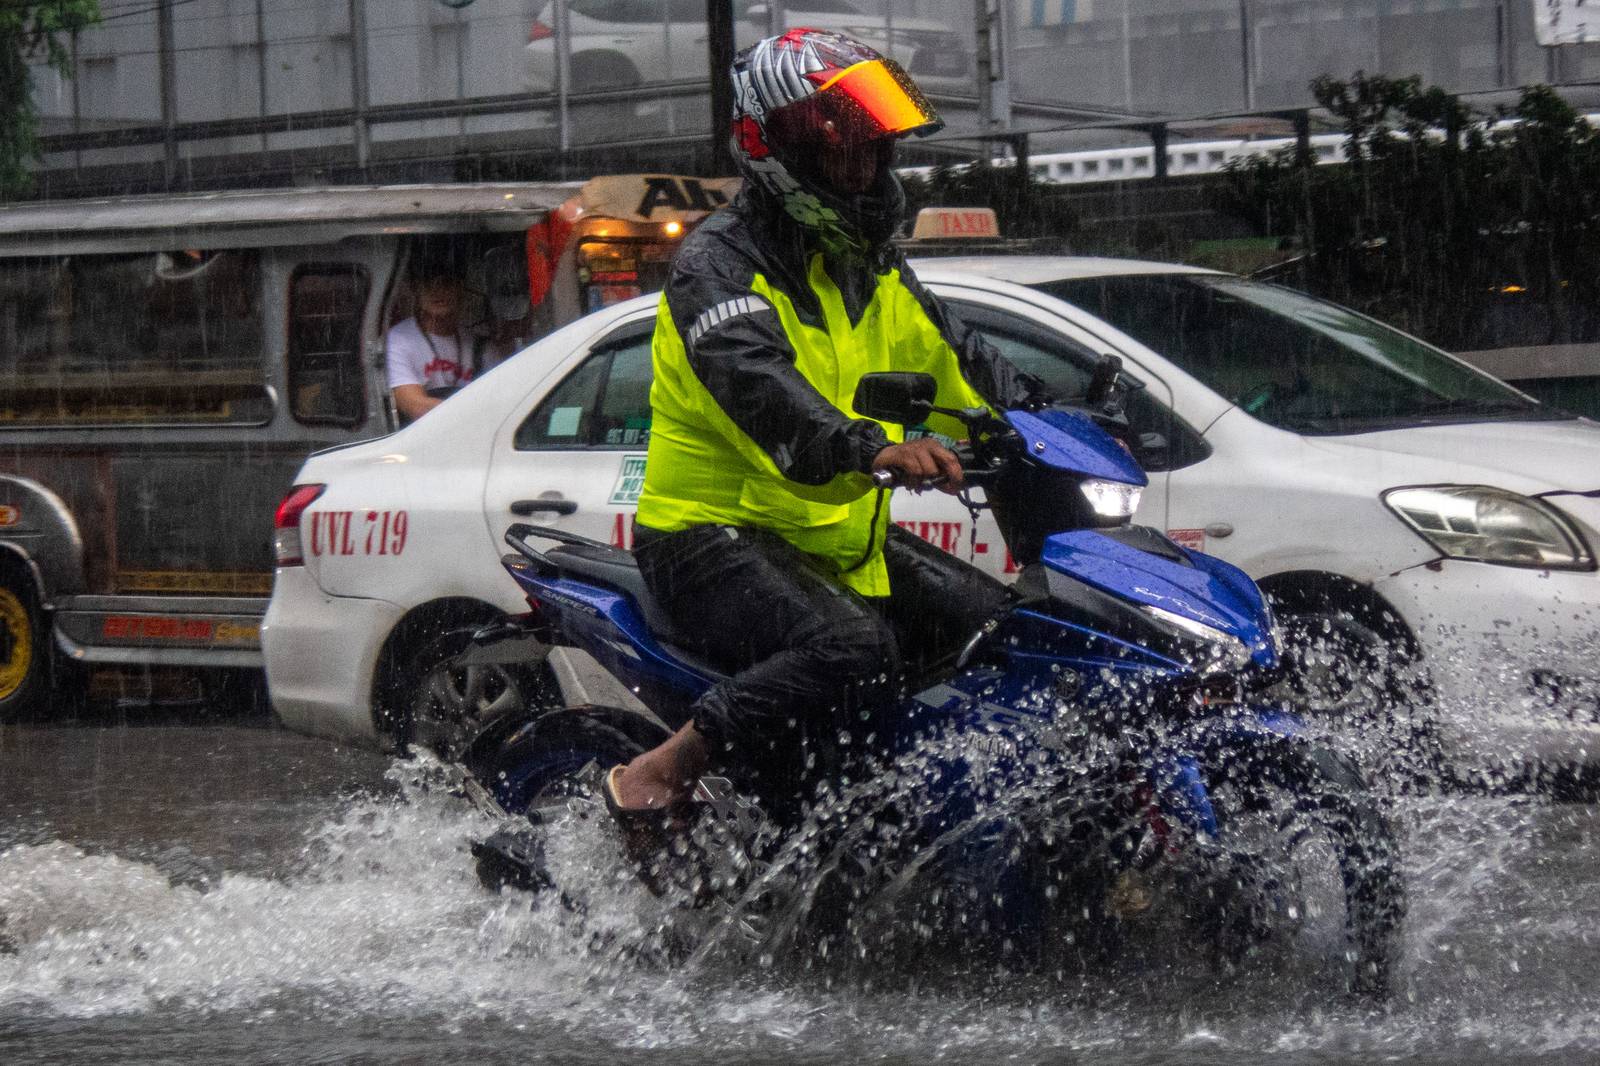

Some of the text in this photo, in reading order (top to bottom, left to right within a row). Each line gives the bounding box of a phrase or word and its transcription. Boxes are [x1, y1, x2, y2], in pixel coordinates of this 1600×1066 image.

[937, 211, 991, 234] TAXI
[310, 510, 408, 556] UVL 719
[541, 588, 598, 616] SNIPER
